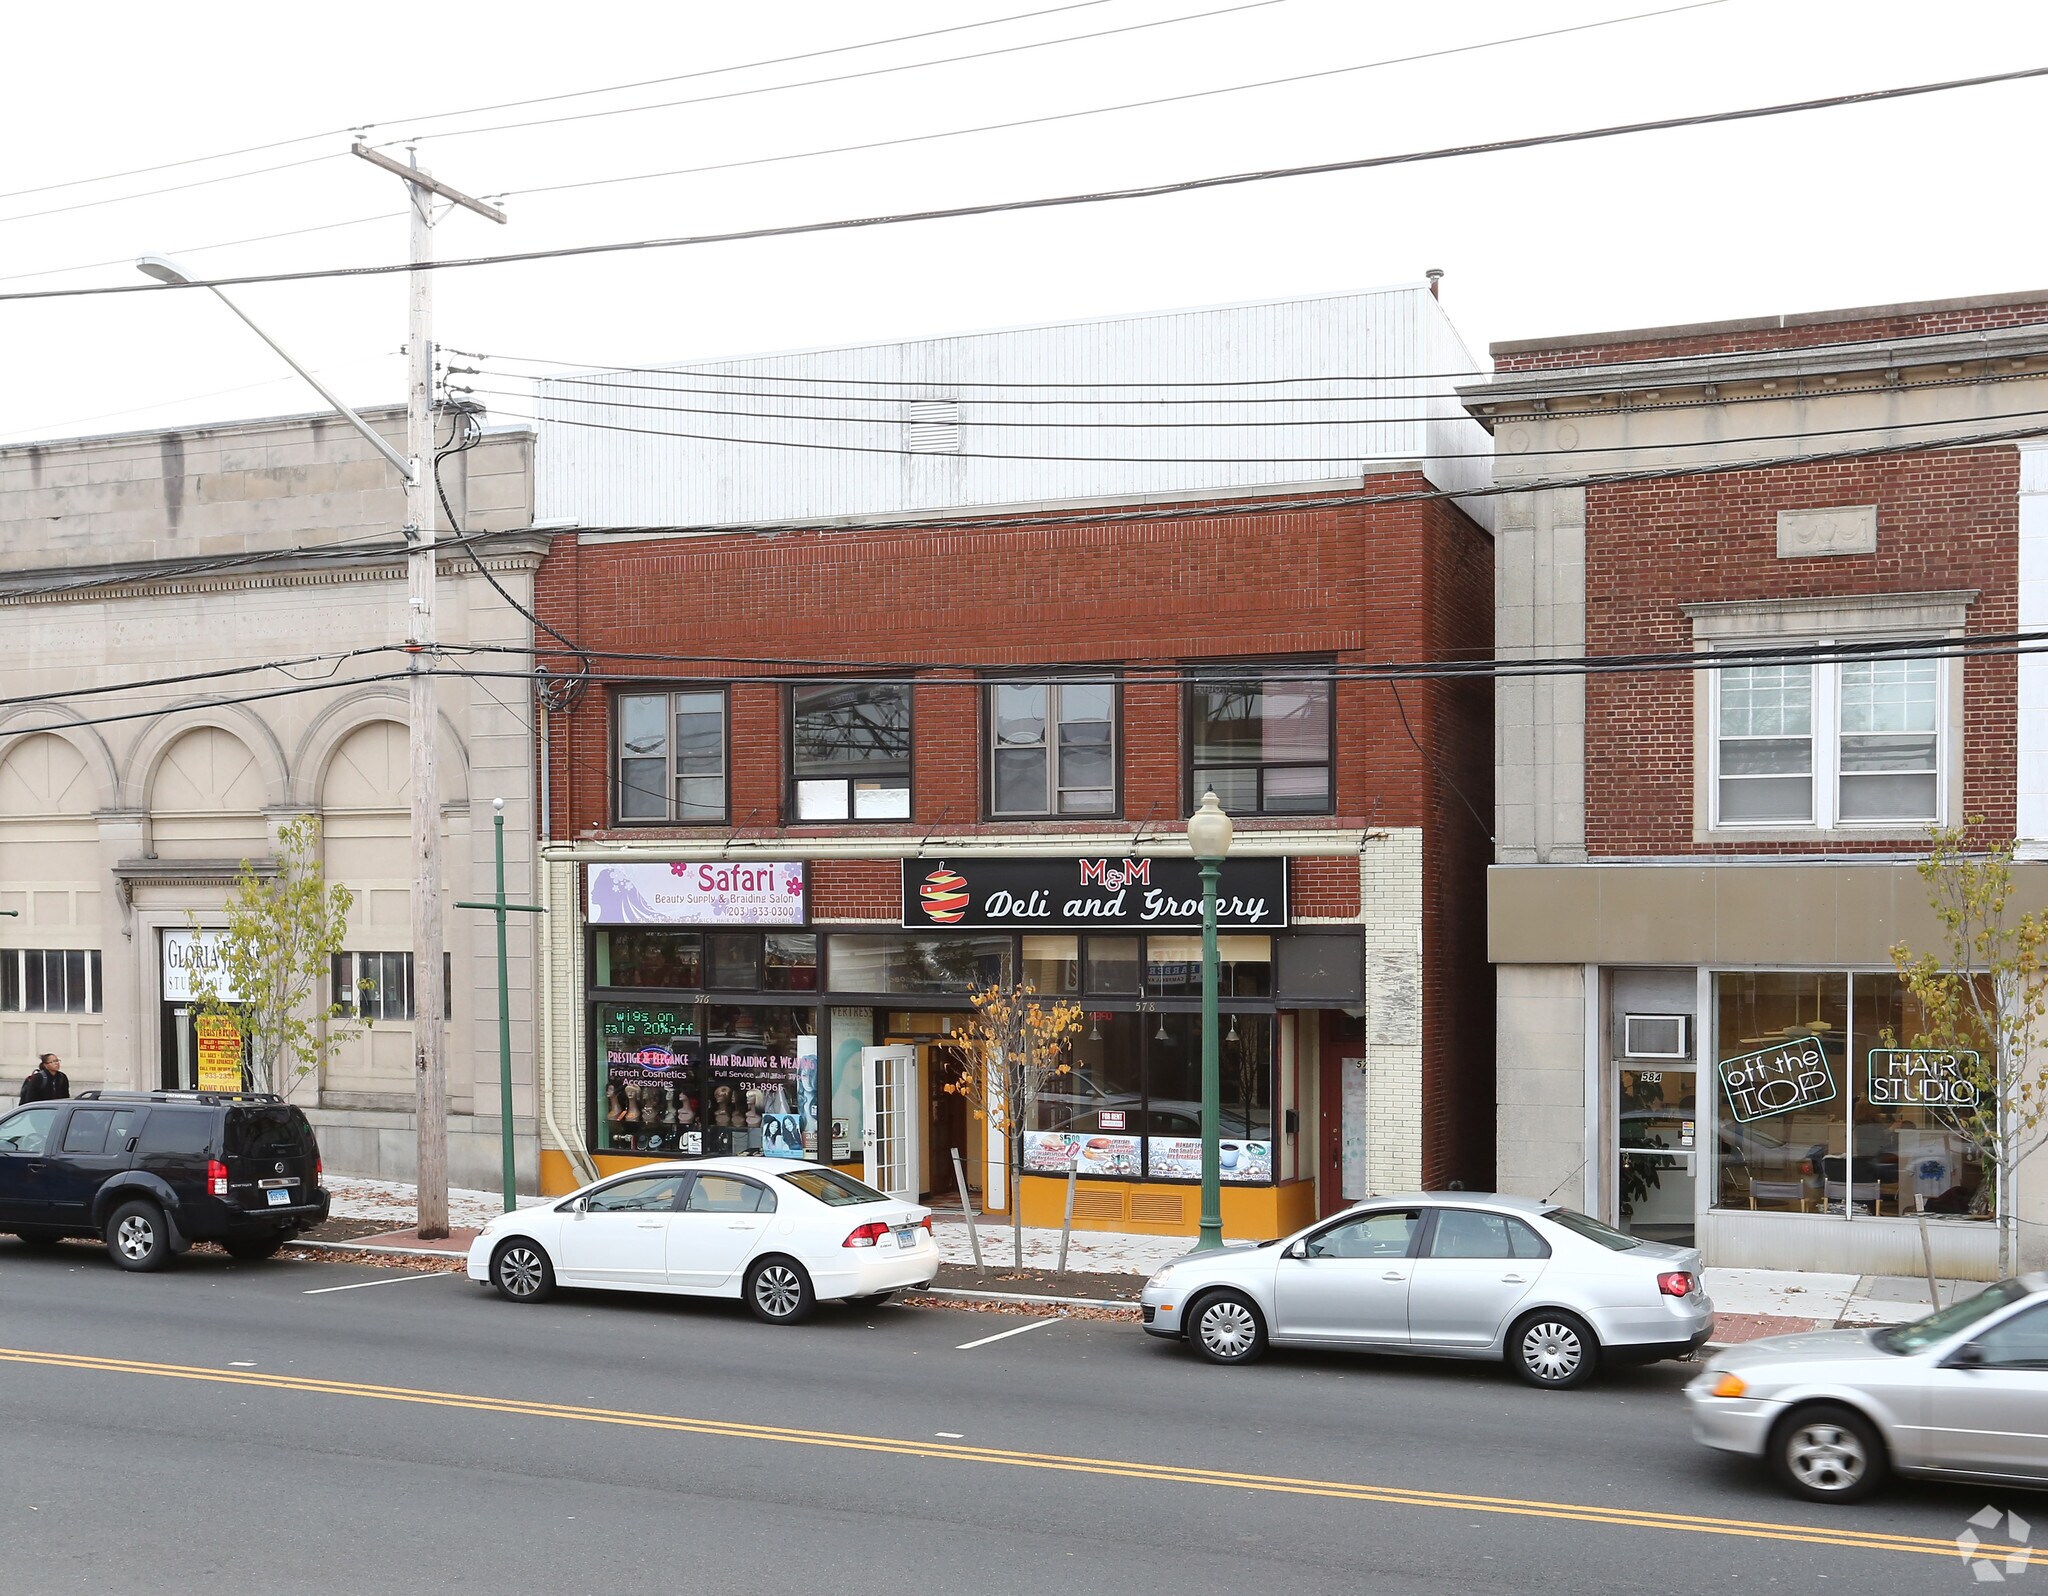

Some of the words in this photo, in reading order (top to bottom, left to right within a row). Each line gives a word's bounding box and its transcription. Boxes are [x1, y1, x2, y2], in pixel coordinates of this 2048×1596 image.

[699, 864, 775, 891] Safari
[1079, 859, 1151, 892] M&M
[655, 894, 685, 904] Beauty
[687, 894, 716, 904] Supply
[719, 894, 726, 903] &
[730, 894, 766, 904] Braiding
[769, 894, 794, 903] Salon
[985, 889, 1050, 918] Deli
[1063, 889, 1127, 918] and
[724, 906, 749, 917] (203)
[752, 906, 794, 916] 933-0300
[694, 995, 709, 1003] 576
[1135, 1002, 1155, 1012] 578
[615, 1009, 649, 1022] wigs
[657, 1013, 674, 1022] on
[605, 1022, 635, 1034] sale
[608, 1050, 642, 1064] PRESTIGE
[710, 1054, 729, 1067] HAIR
[731, 1054, 767, 1068] BRAIDING
[769, 1055, 778, 1068] &
[609, 1068, 639, 1077] French
[642, 1069, 687, 1079] Cosmetics
[715, 1070, 727, 1078] Full
[1728, 1056, 1765, 1086] off
[1775, 1051, 1819, 1073] the
[623, 1078, 674, 1087] Accessories
[1641, 1072, 1662, 1082] 584
[1731, 1071, 1826, 1114] TOP
[1874, 1078, 1974, 1102] STUDIO
